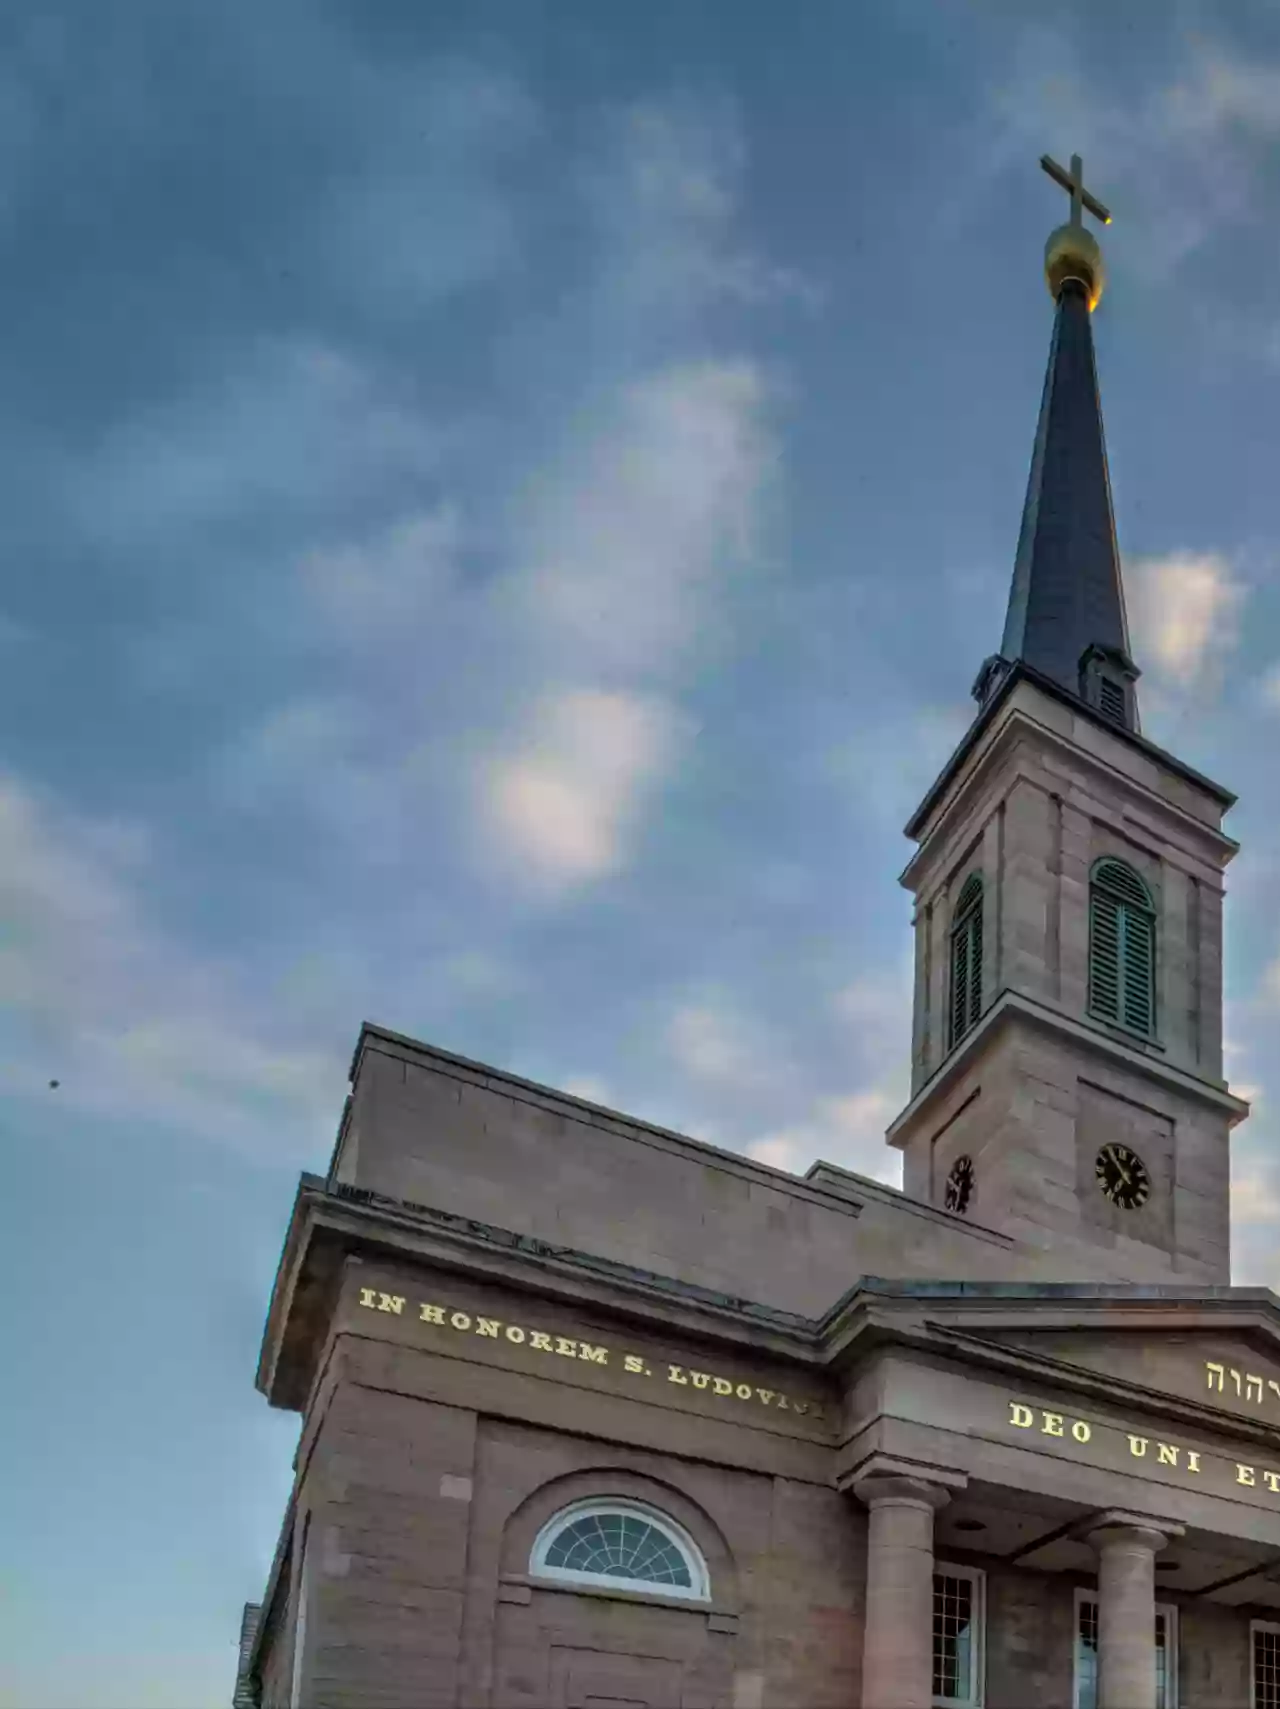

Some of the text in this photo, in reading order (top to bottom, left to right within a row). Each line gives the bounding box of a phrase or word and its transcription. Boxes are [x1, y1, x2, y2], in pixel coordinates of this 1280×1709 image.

[359, 1287, 406, 1315] IN
[419, 1303, 609, 1365] HONOREM
[624, 1355, 652, 1376] S.
[1206, 1362, 1280, 1404] יהוה
[1009, 1402, 1091, 1443] DEO
[1127, 1434, 1200, 1472] UNI
